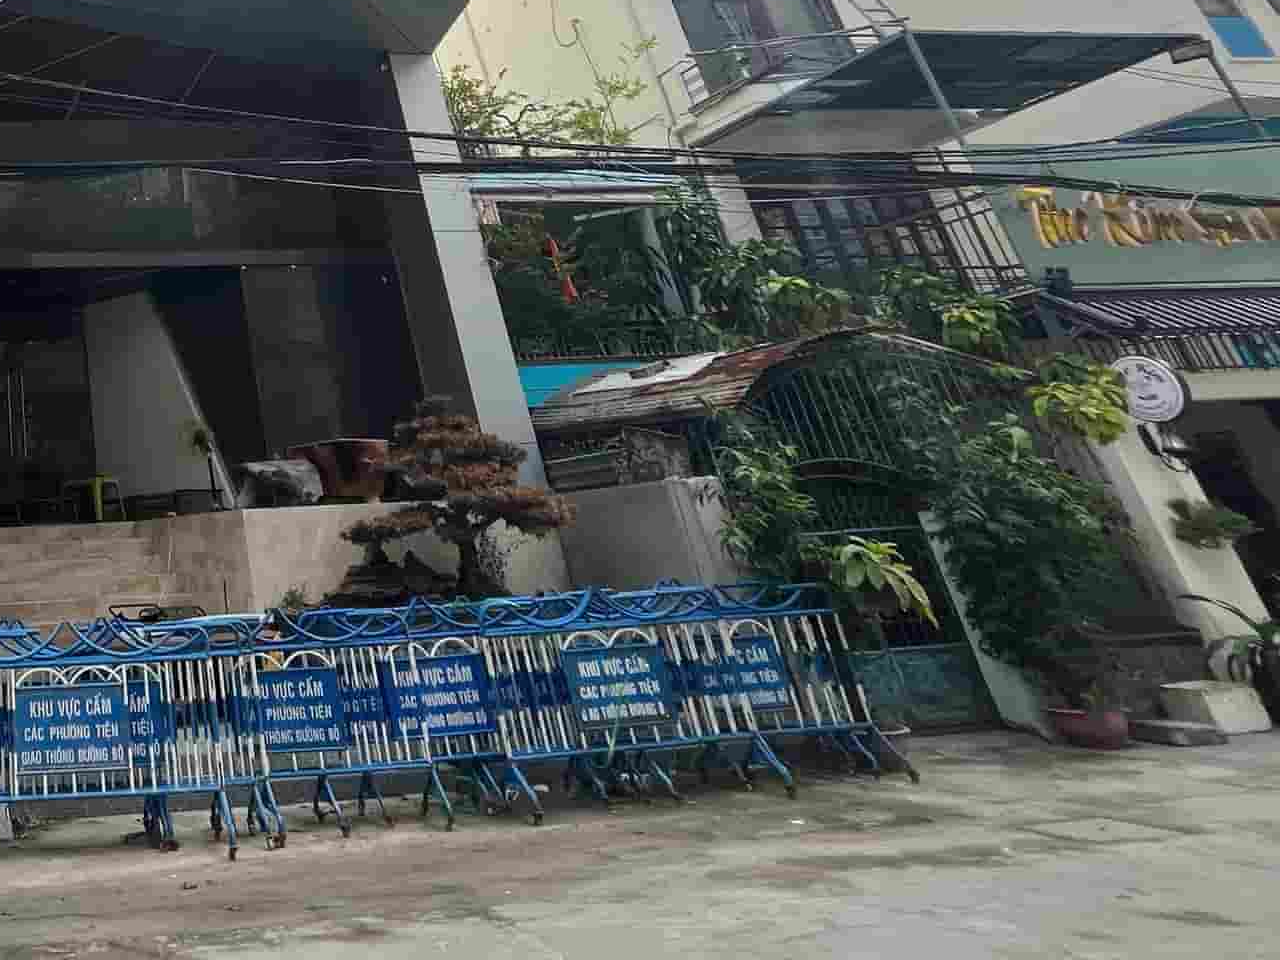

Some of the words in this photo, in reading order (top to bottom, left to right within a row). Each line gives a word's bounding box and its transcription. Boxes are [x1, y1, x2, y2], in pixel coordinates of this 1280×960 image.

[272, 680, 296, 700] VỰC
[298, 676, 324, 697] CẤM
[29, 698, 53, 718] KHU
[57, 696, 81, 720] VỰC
[86, 689, 112, 716] CẤM
[24, 723, 45, 742] CÁC
[96, 720, 119, 739] TIỆN
